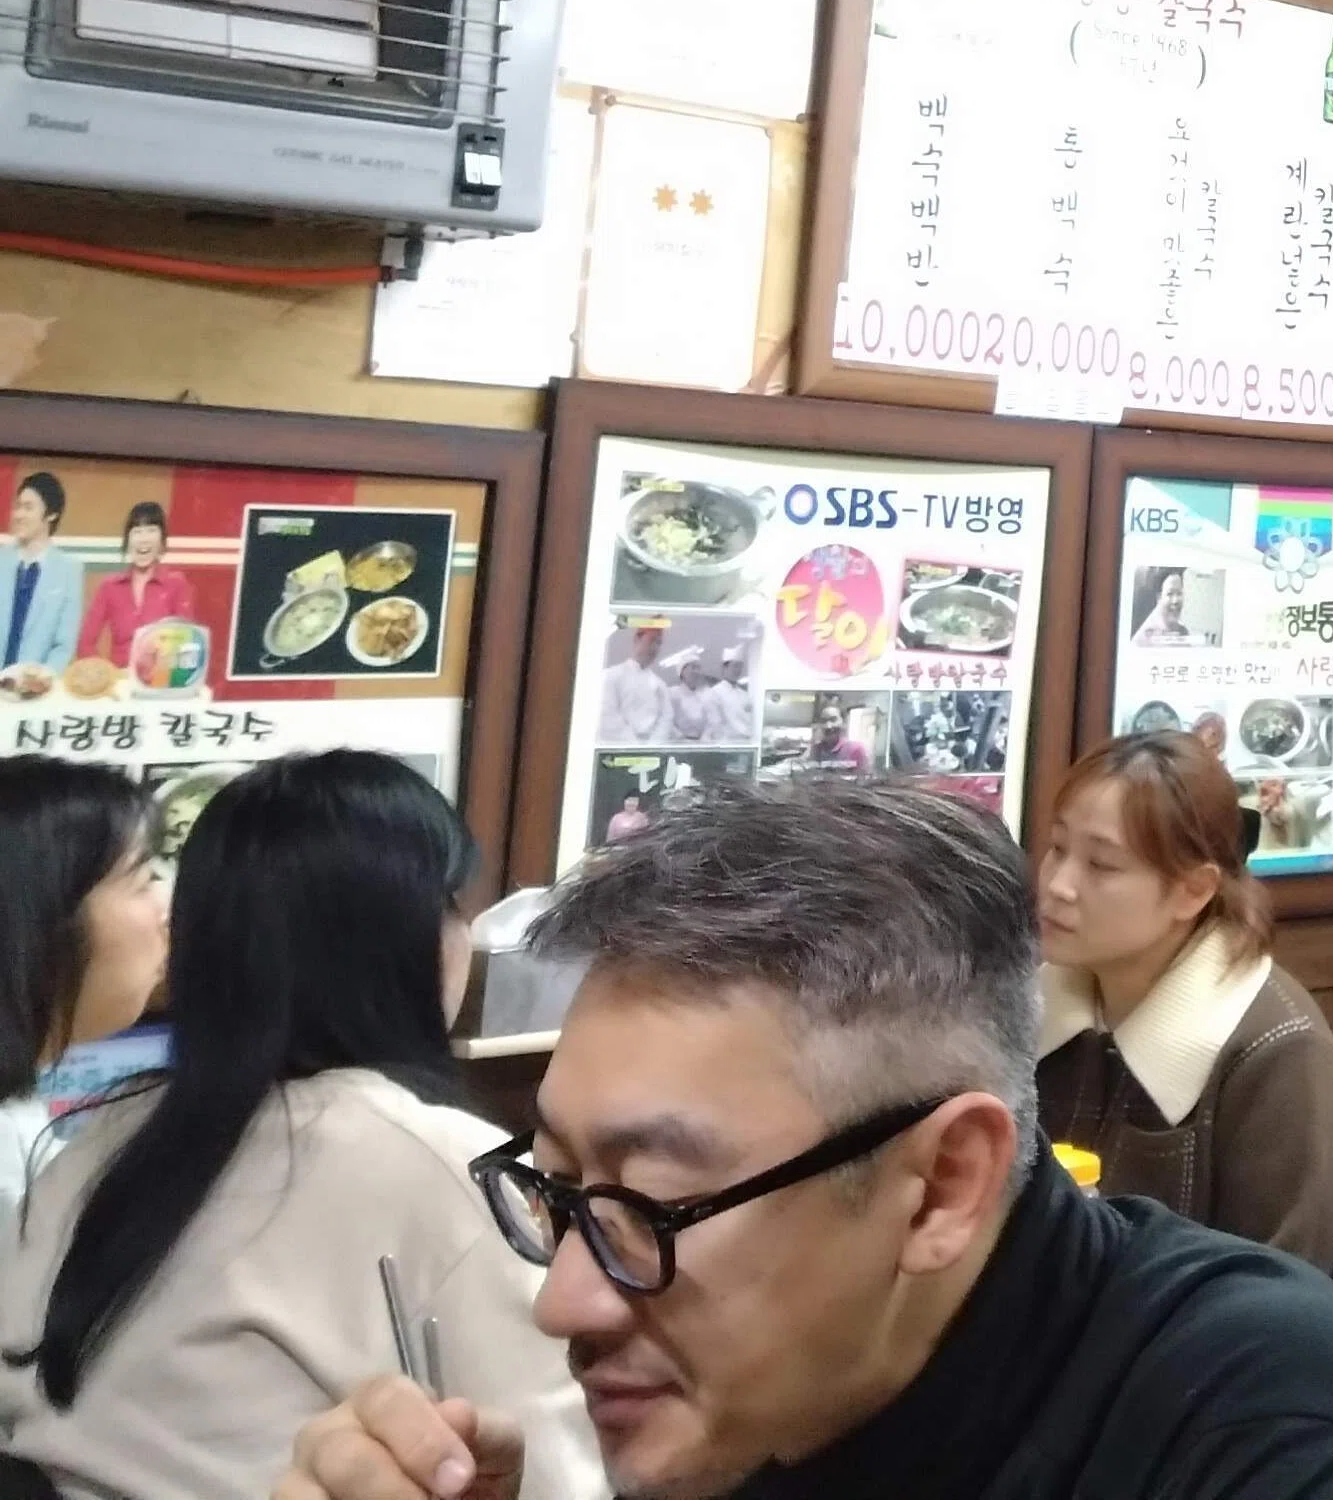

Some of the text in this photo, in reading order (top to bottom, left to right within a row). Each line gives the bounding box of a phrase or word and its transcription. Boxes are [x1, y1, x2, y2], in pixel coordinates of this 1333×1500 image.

[1129, 507, 1179, 534] KBS
[16, 710, 274, 749] 사랑방 칼국수
